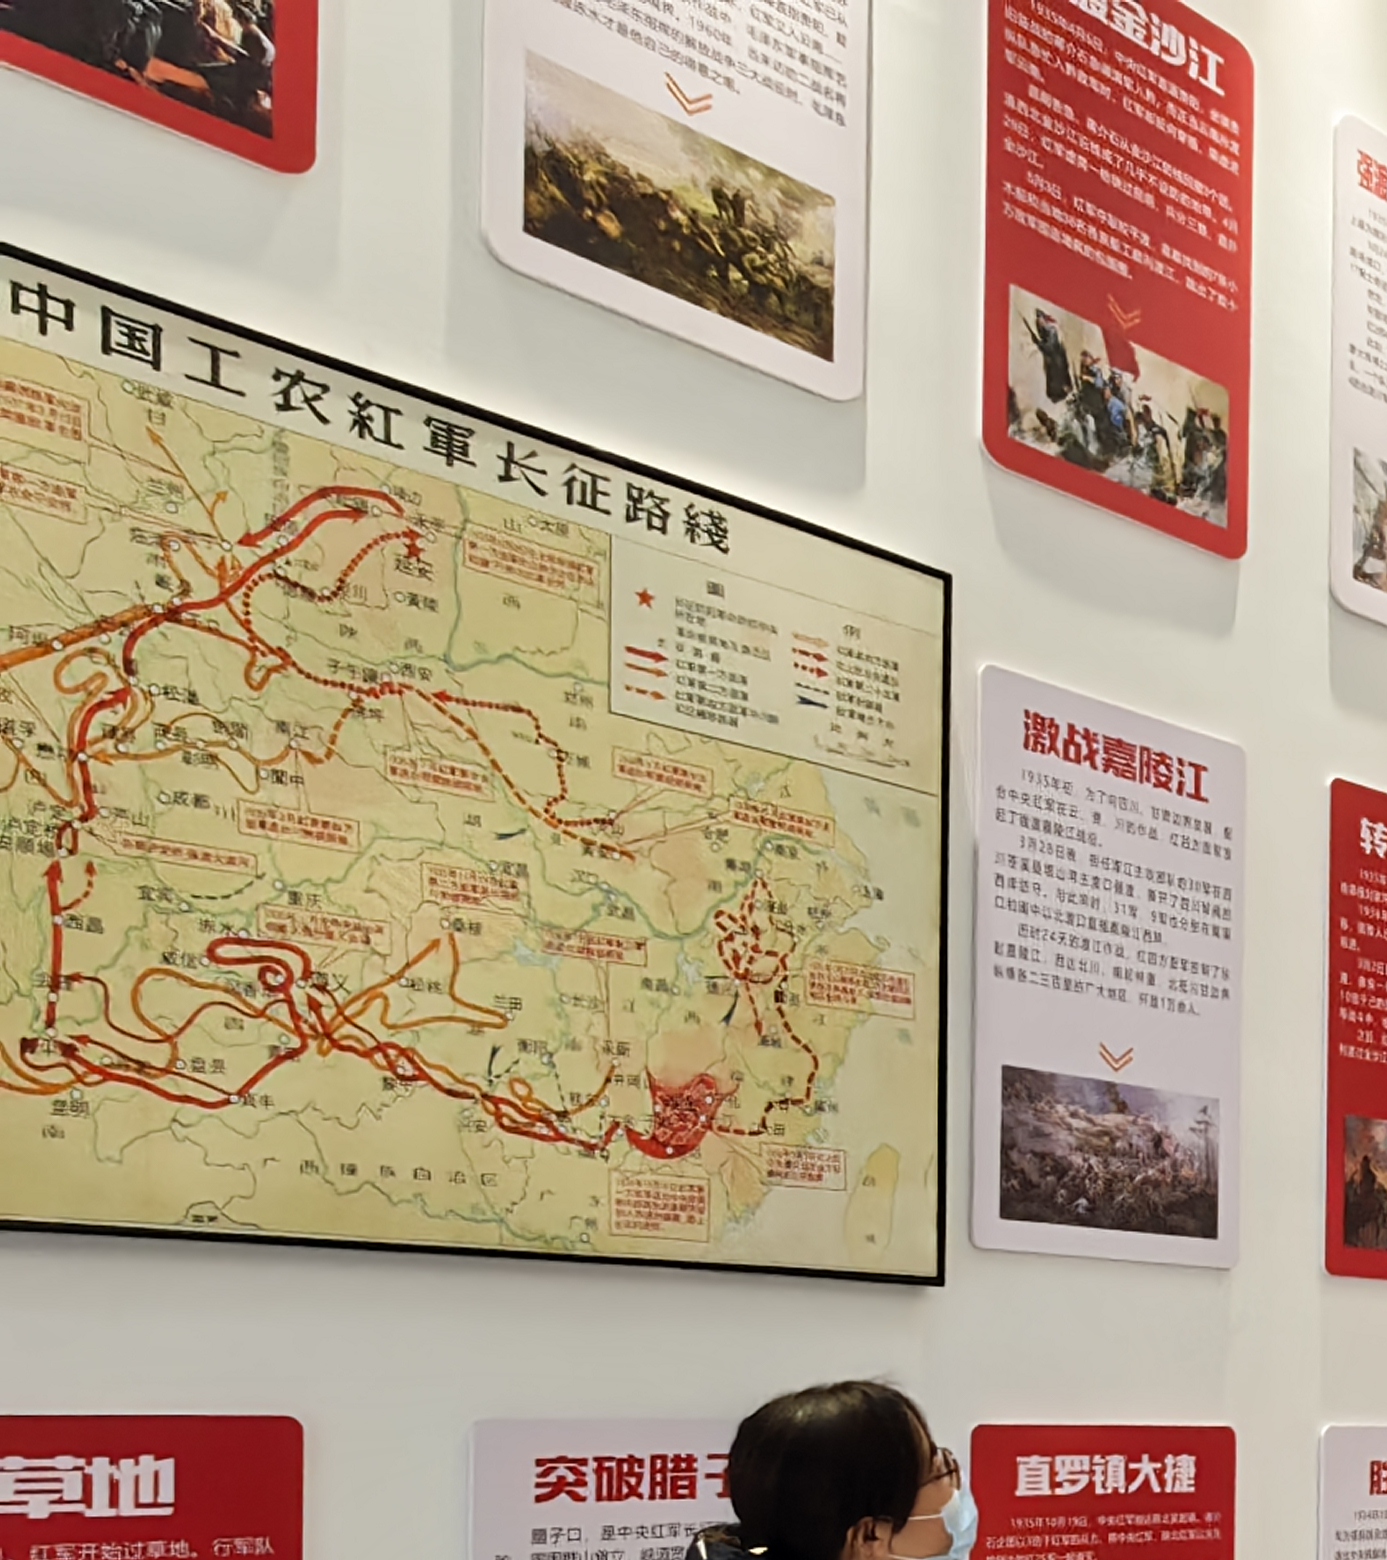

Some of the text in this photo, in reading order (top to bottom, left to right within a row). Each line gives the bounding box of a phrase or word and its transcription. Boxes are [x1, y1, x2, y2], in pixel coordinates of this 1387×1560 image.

[1022, 708, 1210, 804] 激战嘉陵江
[1015, 1453, 1198, 1497] 直罗镇大捷
